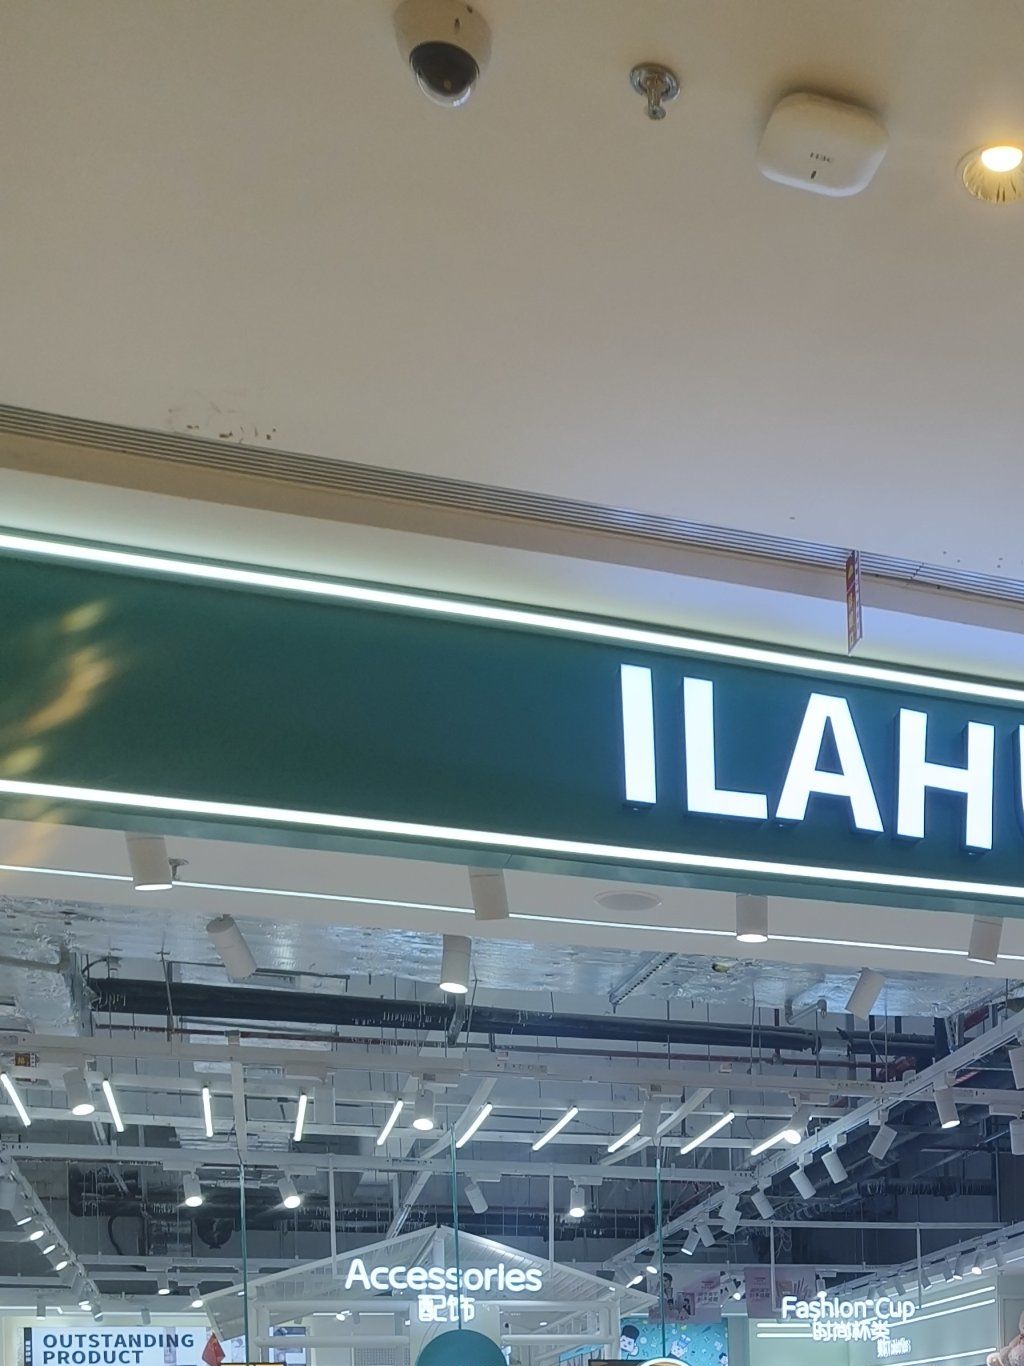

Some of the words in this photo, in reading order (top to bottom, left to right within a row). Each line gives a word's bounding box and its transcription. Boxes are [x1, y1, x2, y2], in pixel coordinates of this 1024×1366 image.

[344, 1258, 543, 1292] Accessories
[417, 1294, 475, 1323] 配饰
[781, 1295, 867, 1320] Fashion
[875, 1297, 916, 1323] Cup
[43, 1333, 194, 1348] OUTSTANDING
[812, 1320, 890, 1342] 时尚杯类
[43, 1350, 144, 1365] PRODUCT
